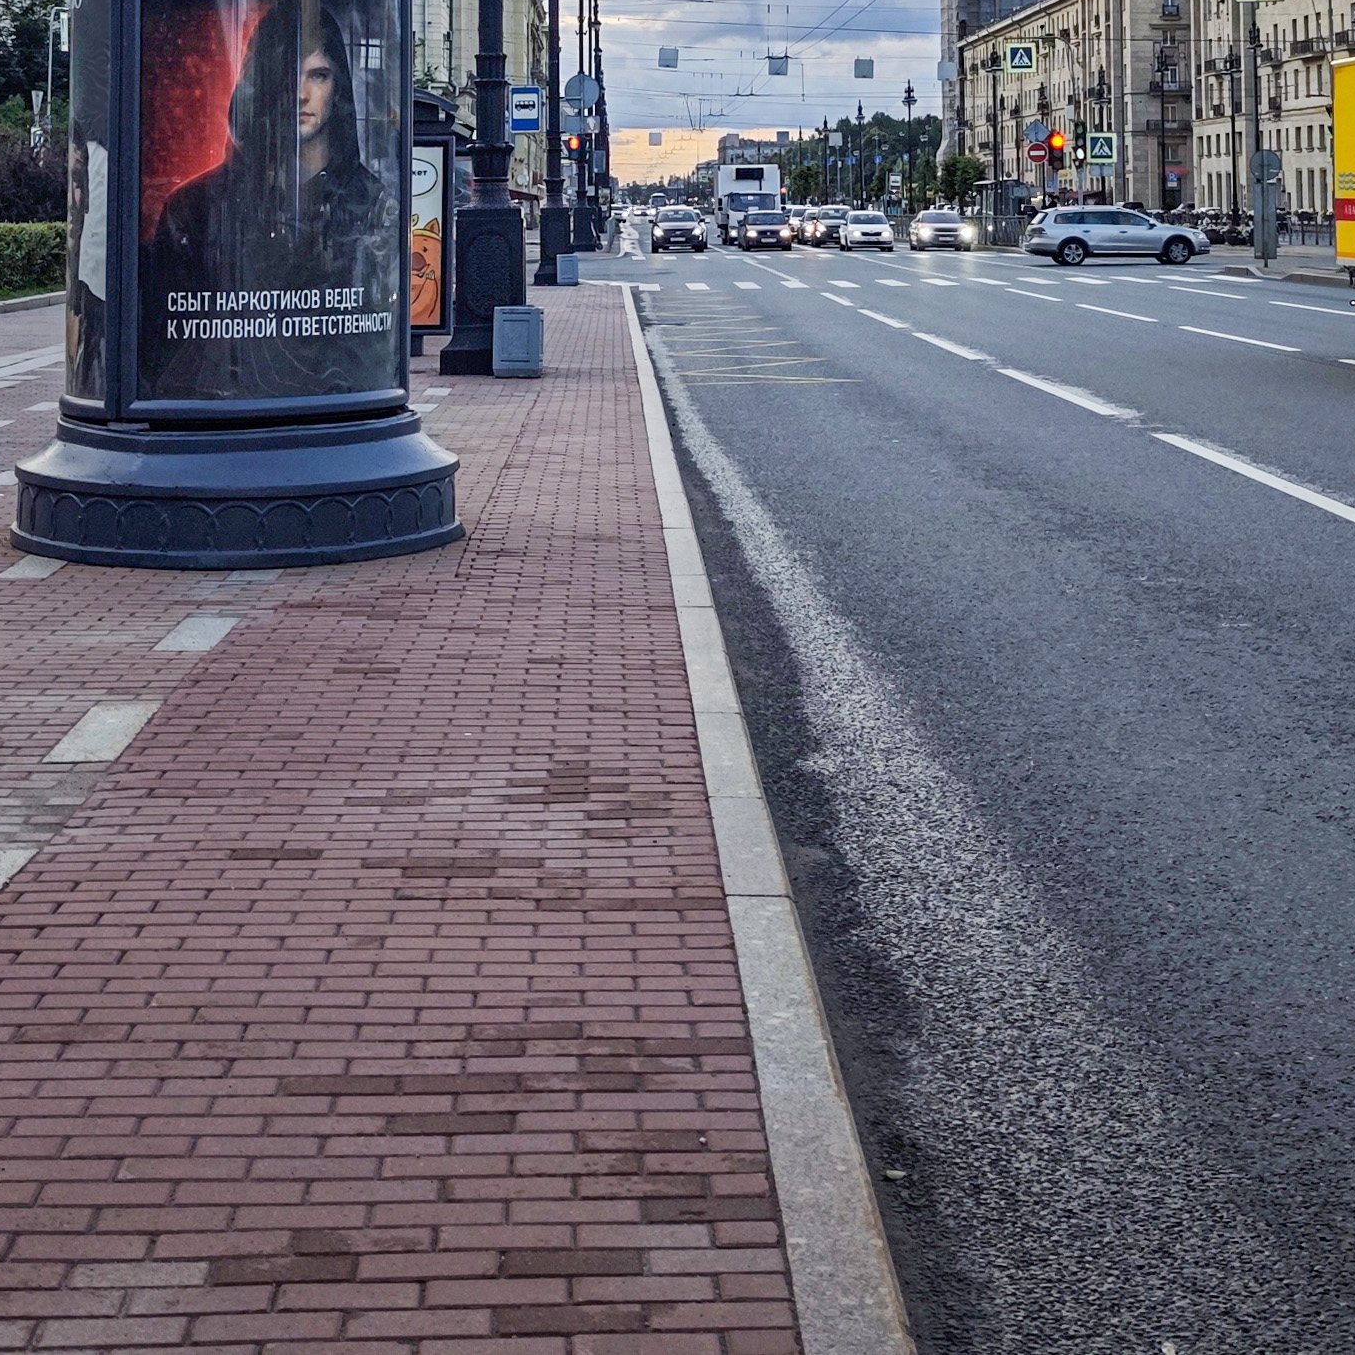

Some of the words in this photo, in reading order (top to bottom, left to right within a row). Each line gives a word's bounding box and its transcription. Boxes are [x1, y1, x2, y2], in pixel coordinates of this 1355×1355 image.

[167, 291, 212, 312] СБЫТ
[215, 289, 321, 312] НАРКОТИКОВ
[325, 287, 365, 311] ВЕДЕТ
[167, 319, 179, 339] К
[182, 313, 277, 340] УГОЛОВНОЙ
[281, 311, 393, 337] ОТВЕТСТВЕННОСТИ
